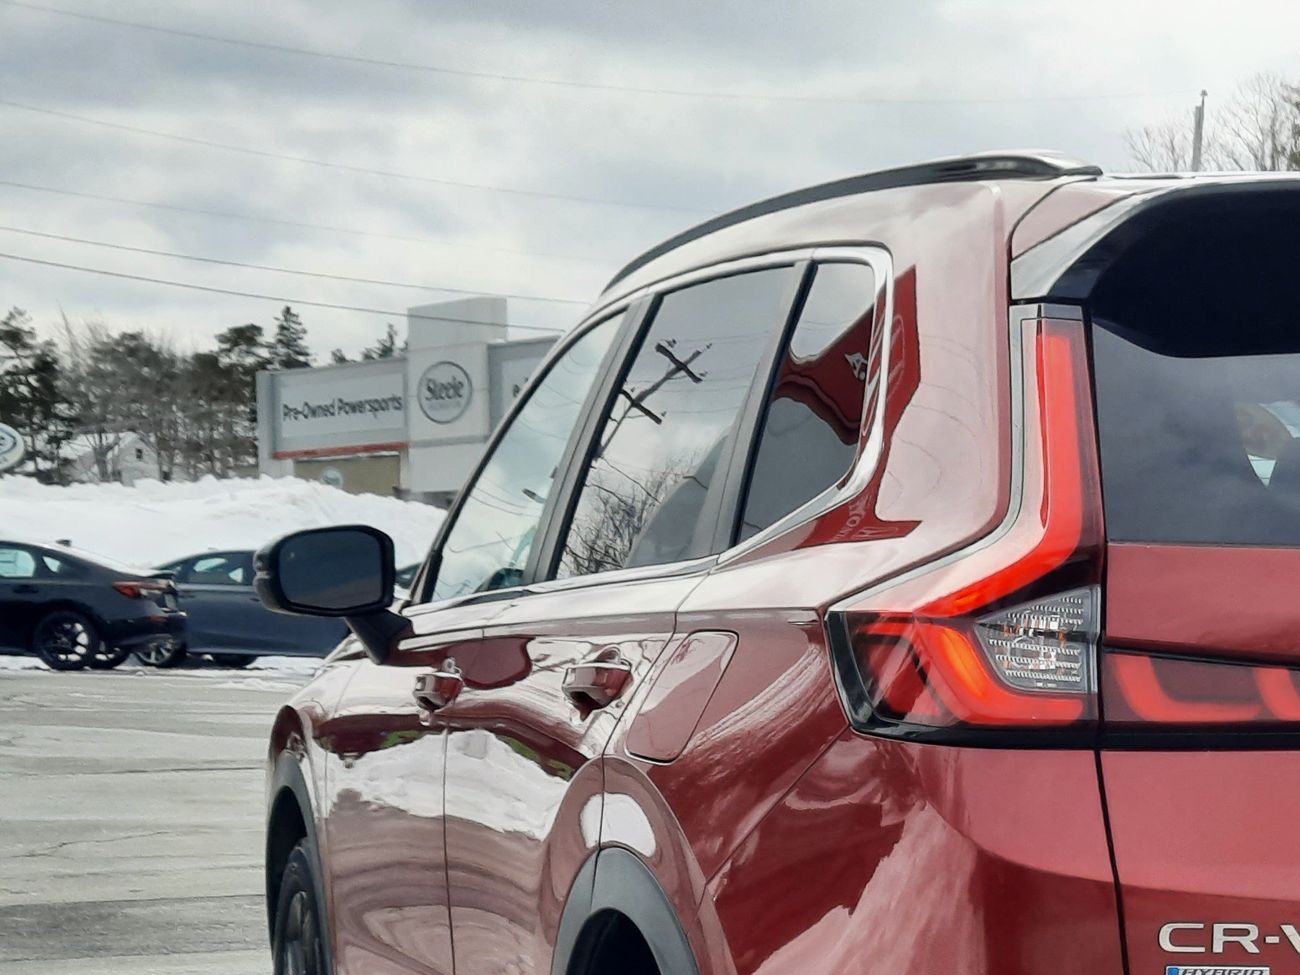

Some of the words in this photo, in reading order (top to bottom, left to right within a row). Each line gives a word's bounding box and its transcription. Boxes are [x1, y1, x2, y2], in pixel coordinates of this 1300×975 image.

[425, 376, 464, 401] Steele
[282, 400, 336, 421] Pre-Owned
[338, 394, 403, 418] Powersports
